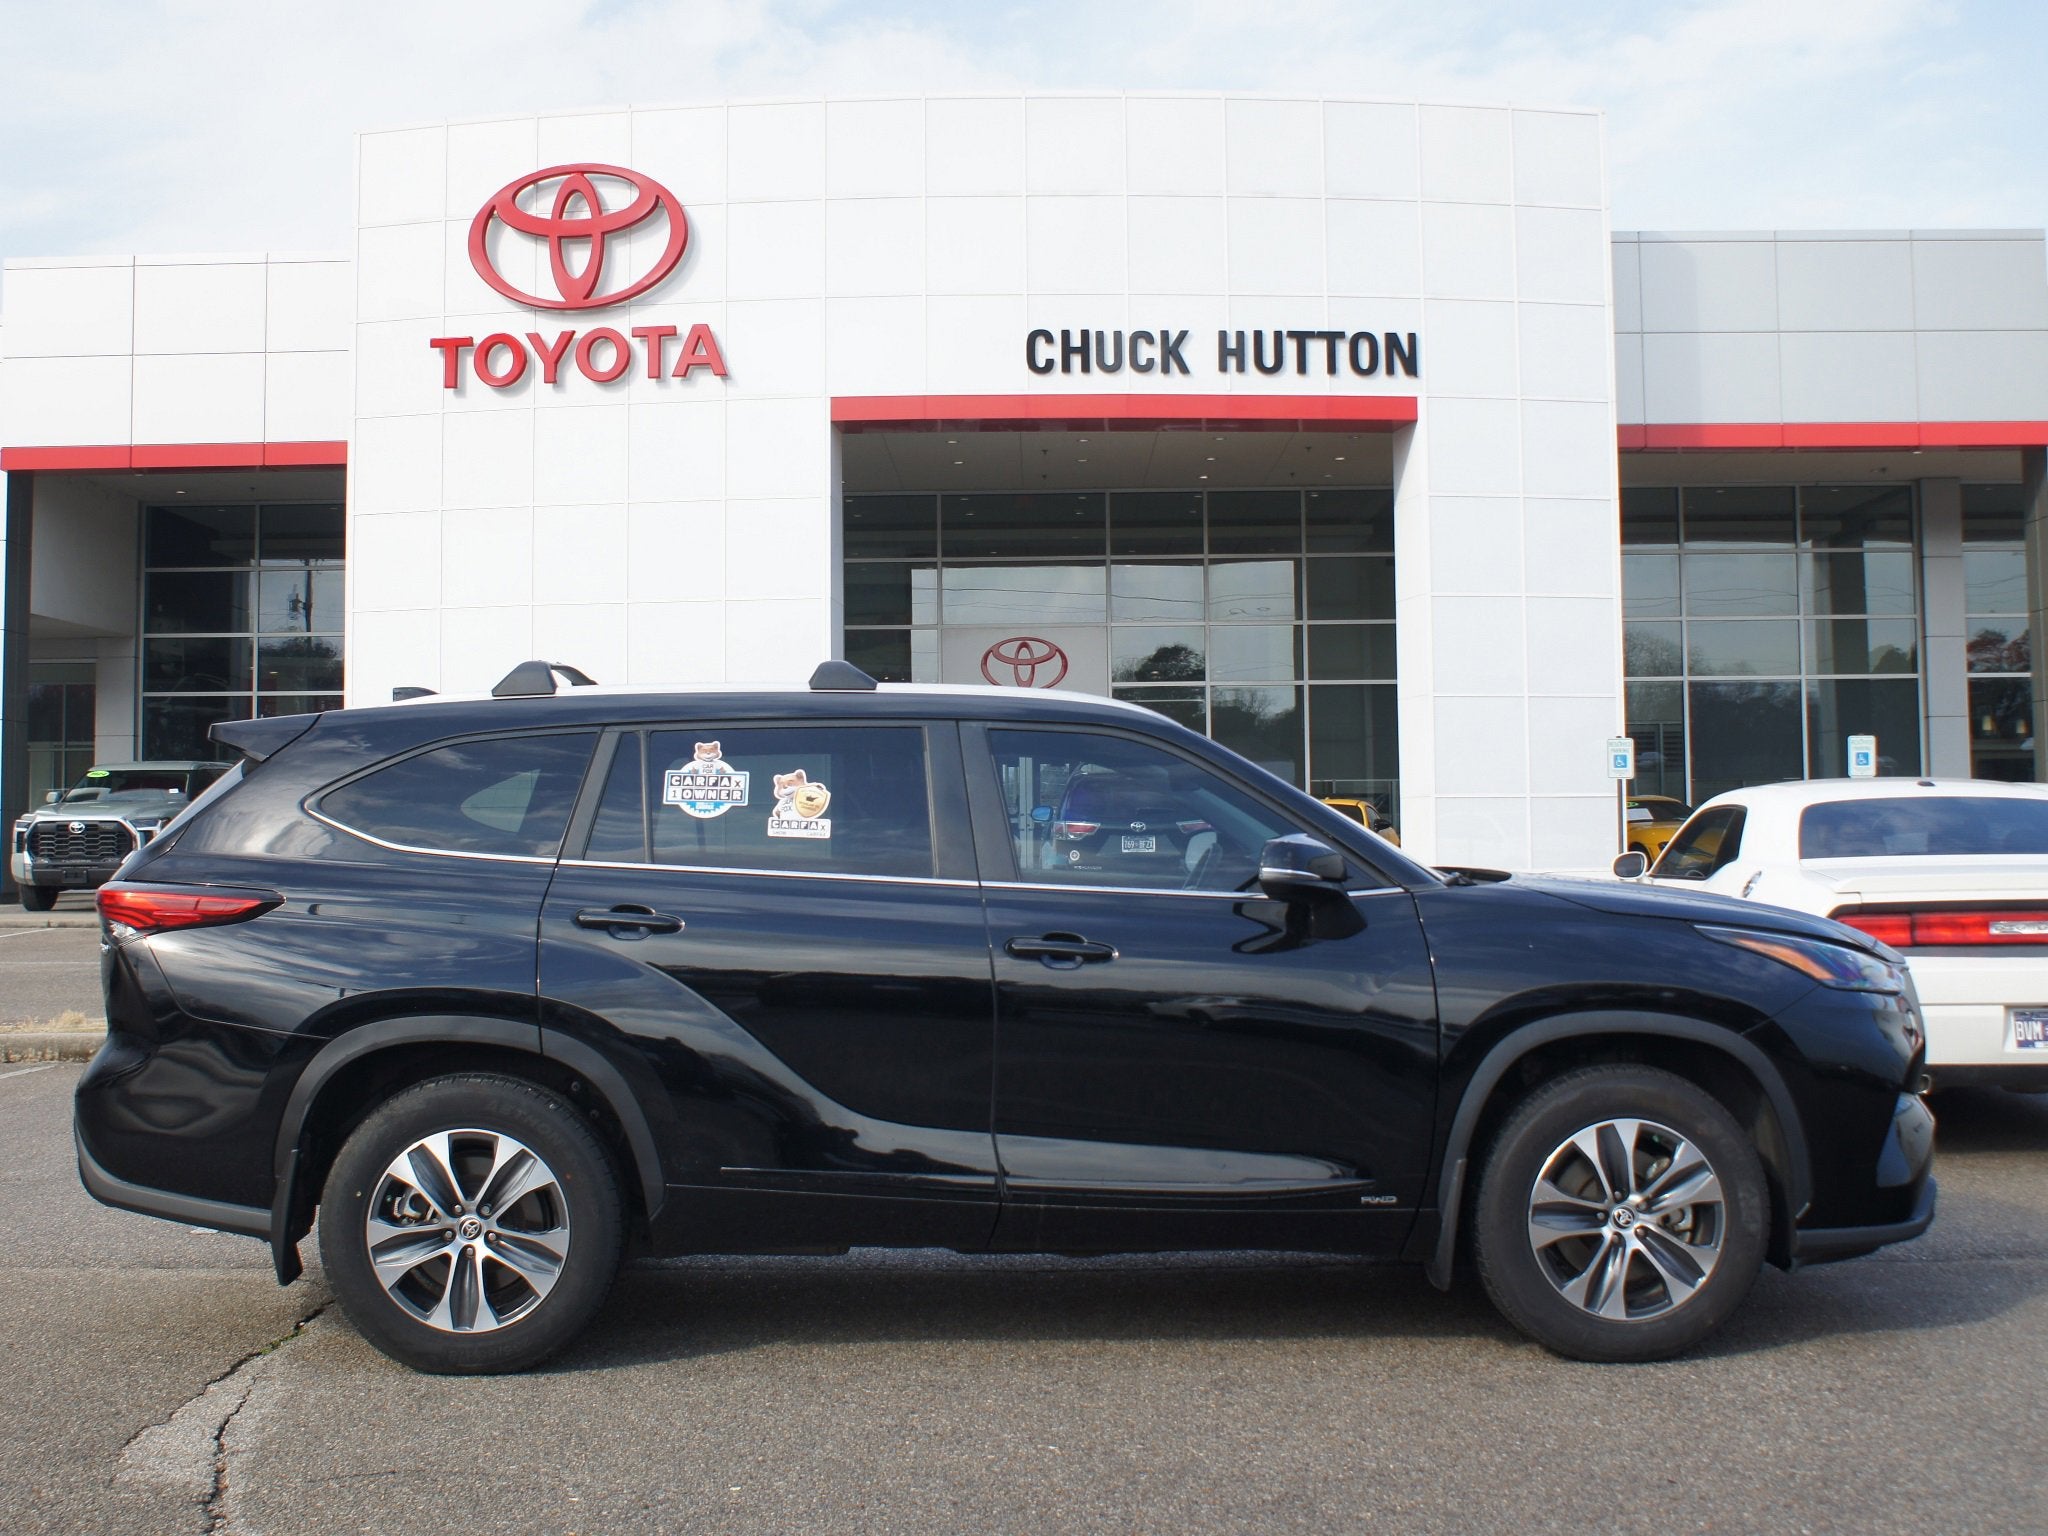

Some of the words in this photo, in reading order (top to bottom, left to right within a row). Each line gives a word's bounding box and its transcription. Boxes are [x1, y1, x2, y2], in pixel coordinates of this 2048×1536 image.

[430, 323, 727, 389] TOYOTA
[1026, 328, 1190, 375] CHUCK
[1217, 329, 1419, 377] HUTTON
[671, 775, 741, 787] CARFAX
[672, 790, 677, 798] 1
[682, 789, 743, 800] OWNER
[771, 820, 826, 830] CARFAX
